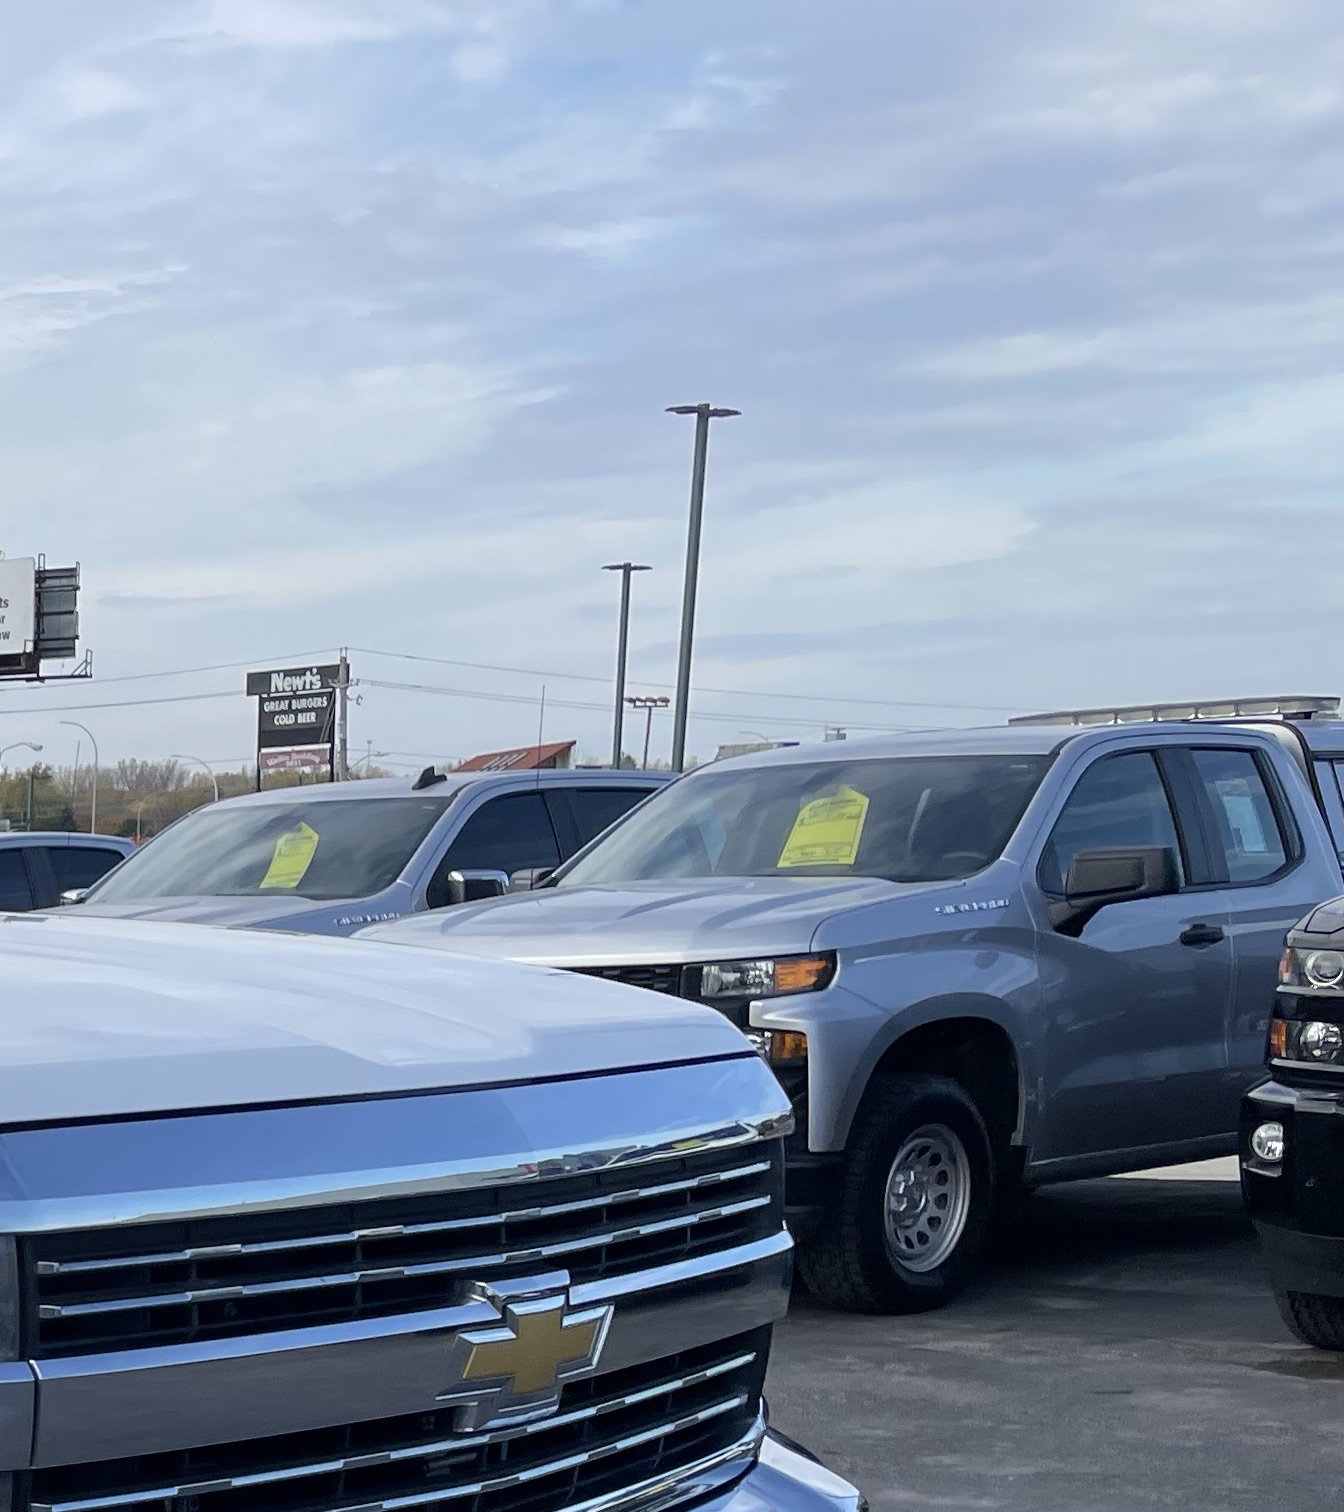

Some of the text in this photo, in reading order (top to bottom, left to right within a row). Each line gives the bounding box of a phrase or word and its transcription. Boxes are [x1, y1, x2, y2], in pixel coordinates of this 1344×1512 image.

[270, 667, 322, 692] Newt's
[264, 696, 328, 713] GREAT BURGERS
[273, 712, 317, 726] COLD BEER
